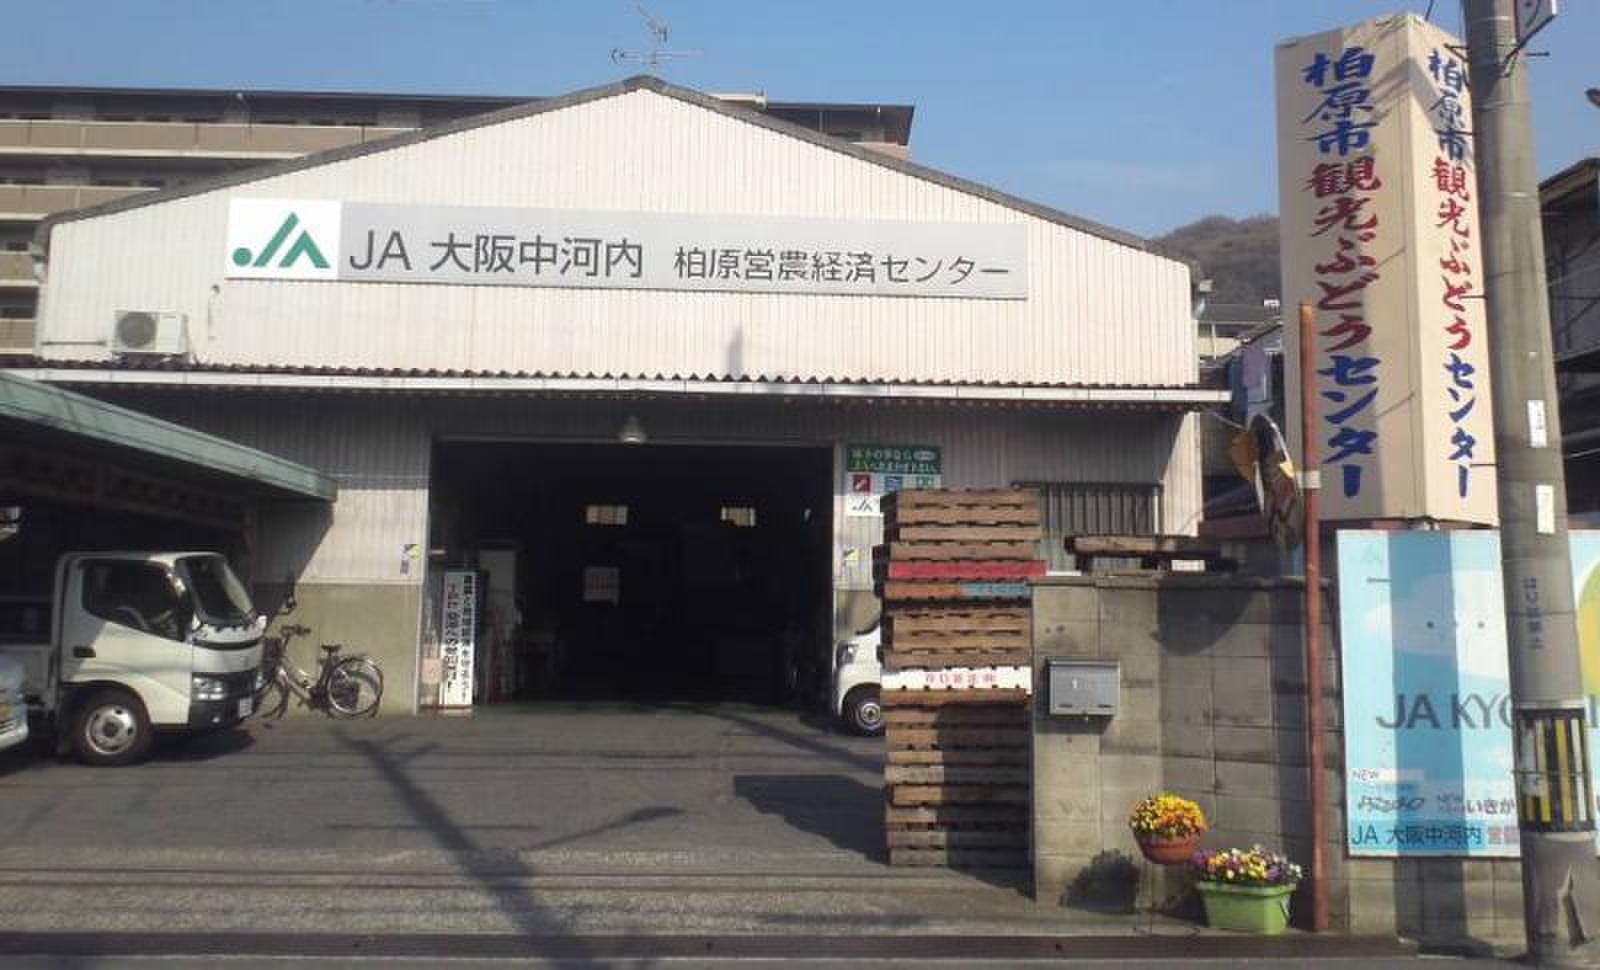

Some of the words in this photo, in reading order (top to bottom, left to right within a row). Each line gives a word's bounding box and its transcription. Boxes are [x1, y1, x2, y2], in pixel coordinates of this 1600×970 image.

[349, 230, 412, 271] JA
[429, 232, 643, 278] 大阪中河内
[674, 245, 1009, 285] 柏原営農経済センター
[1304, 46, 1382, 498] 柏原市観光ぶどうセンター
[1427, 47, 1478, 499] 柏原市観光ぶどうセンター
[1376, 693, 1442, 729] JA
[1351, 824, 1378, 845] JA
[1386, 825, 1482, 846] 大阪中河内
